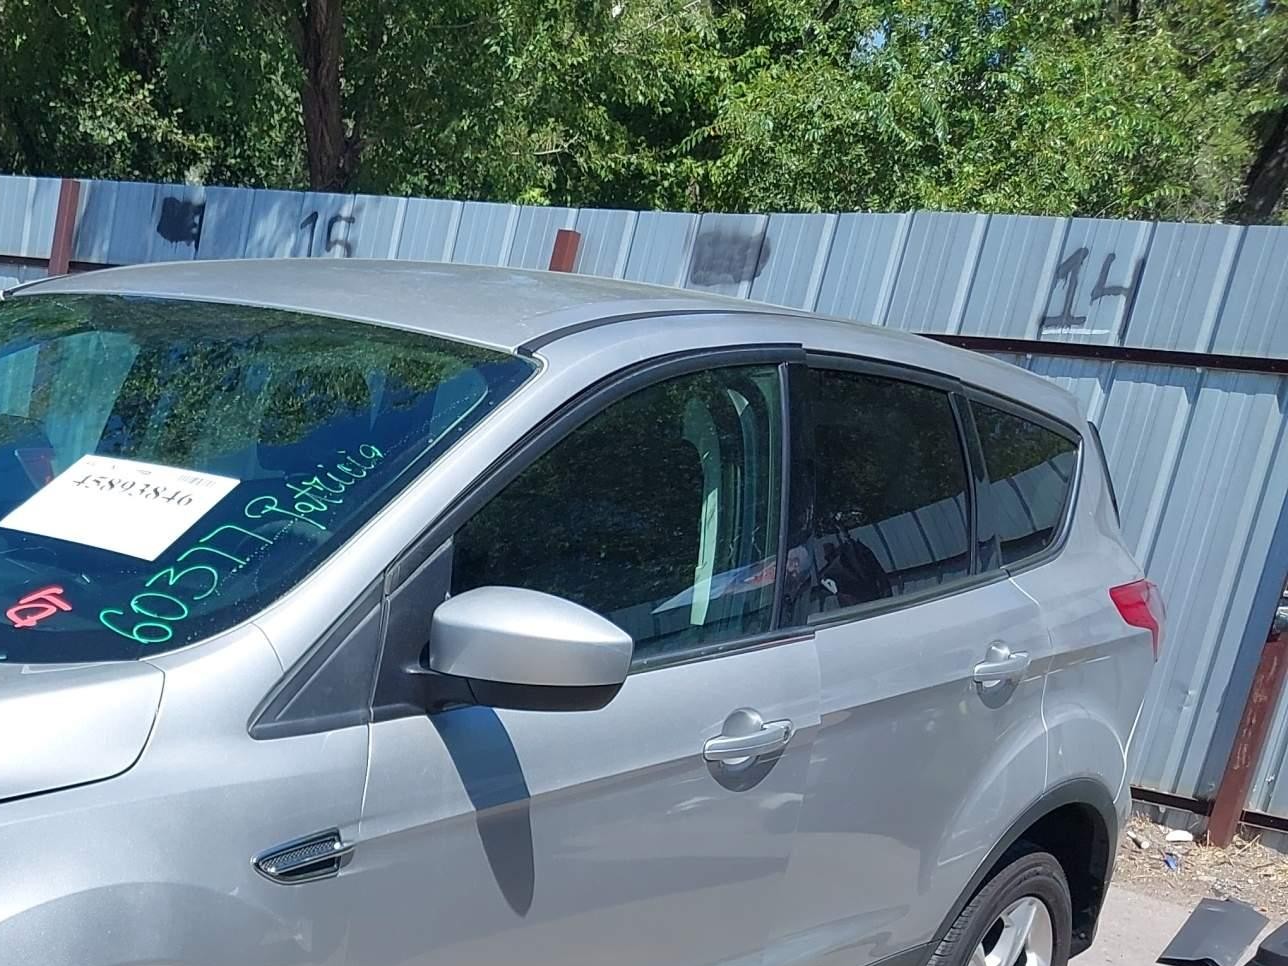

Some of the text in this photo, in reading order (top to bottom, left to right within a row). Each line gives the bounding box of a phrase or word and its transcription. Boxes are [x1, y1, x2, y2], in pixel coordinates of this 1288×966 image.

[300, 211, 355, 258] 15
[1038, 247, 1146, 340] 14
[72, 474, 194, 507] 45893846
[100, 443, 385, 644] 60377 Patricia
